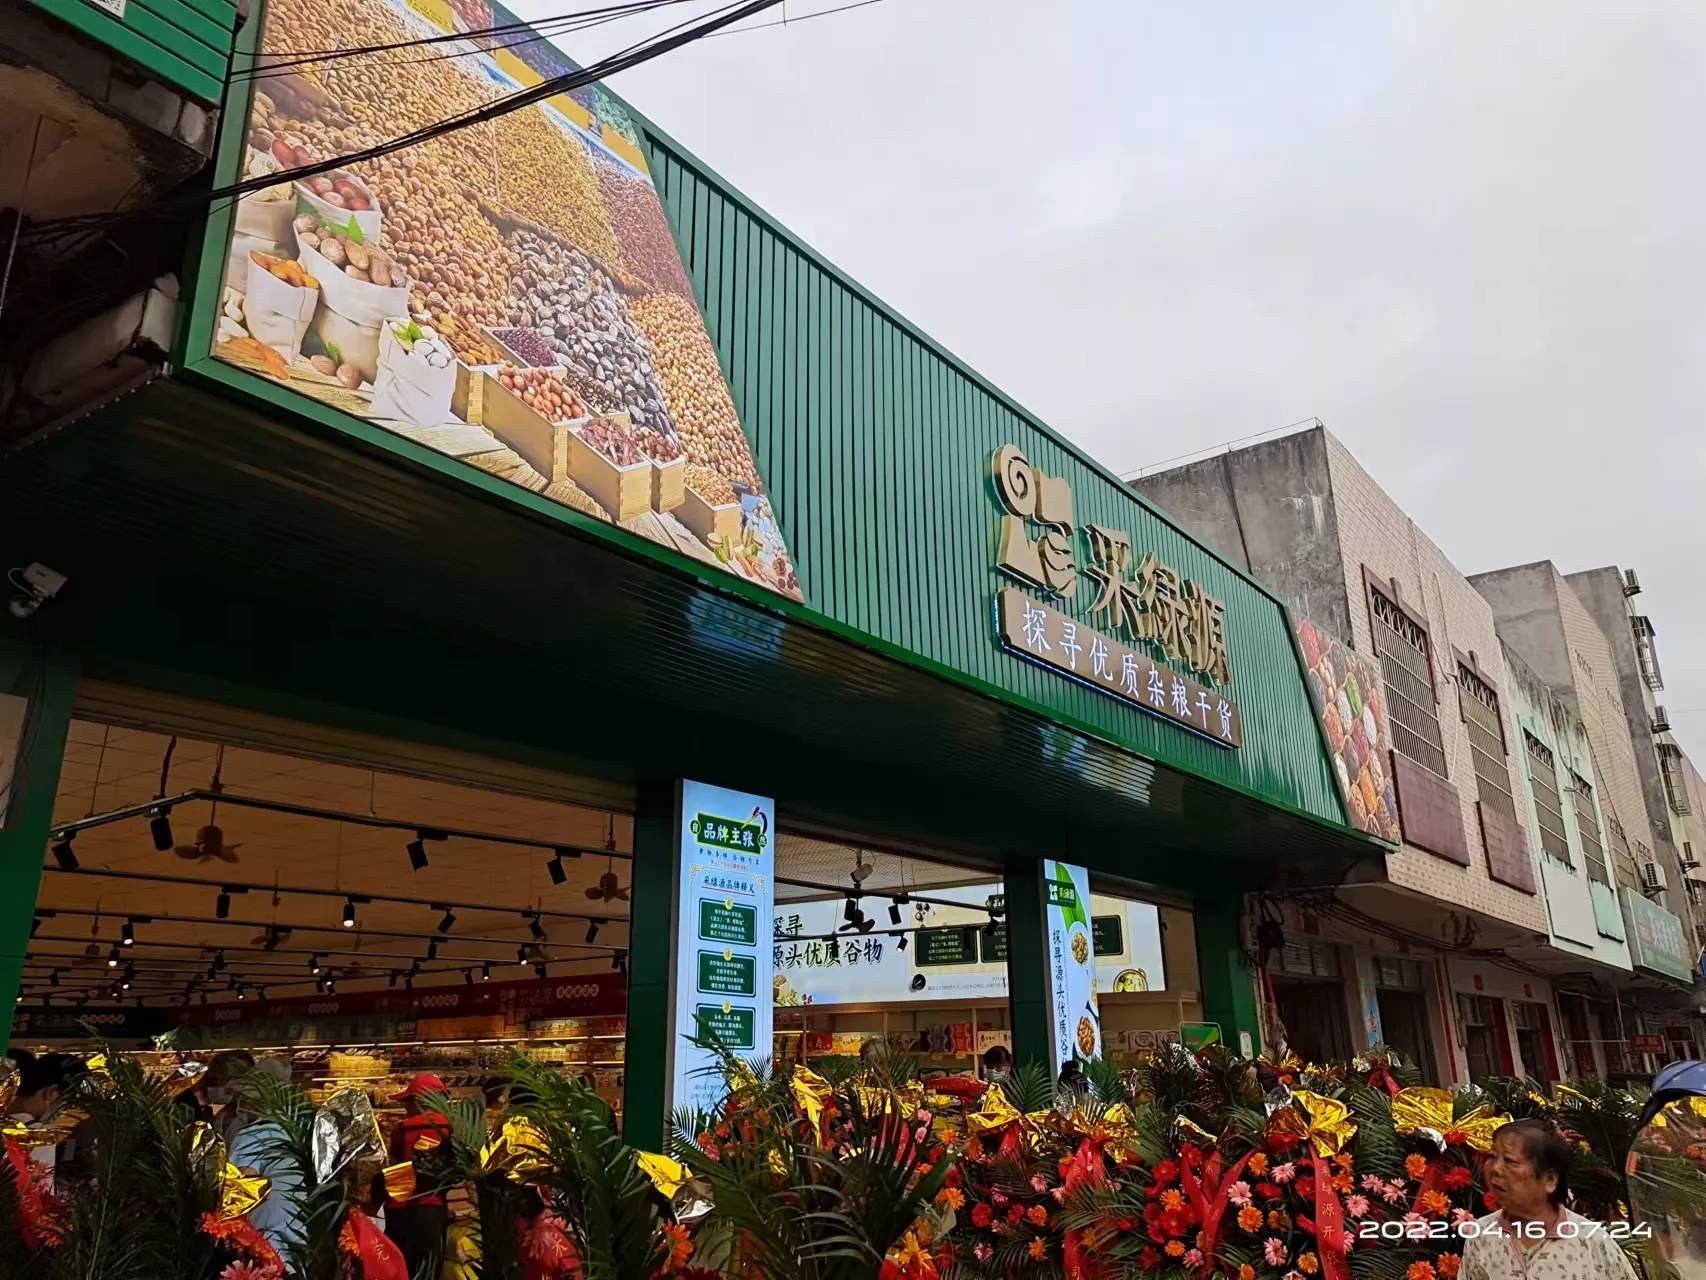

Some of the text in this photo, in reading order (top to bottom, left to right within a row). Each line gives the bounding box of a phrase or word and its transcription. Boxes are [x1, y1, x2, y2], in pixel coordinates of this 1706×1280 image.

[1022, 600, 1233, 741] 探寻优质杂粮干货
[703, 822, 755, 848] 品牌主张
